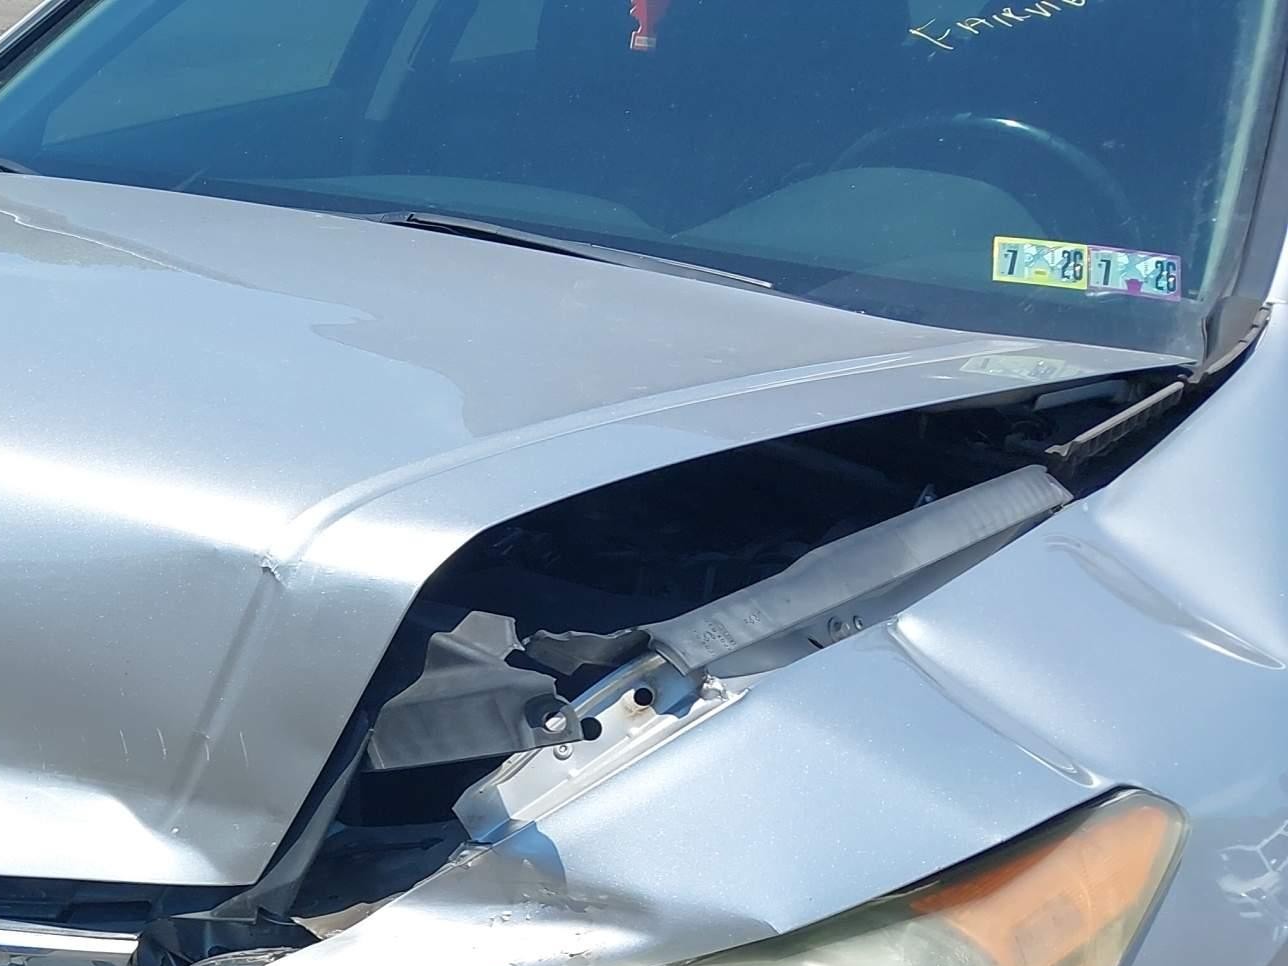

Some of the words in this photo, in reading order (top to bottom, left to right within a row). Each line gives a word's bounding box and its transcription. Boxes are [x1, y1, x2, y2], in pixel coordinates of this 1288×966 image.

[1004, 249, 1018, 276] 7
[1061, 249, 1084, 281] 26
[1099, 259, 1111, 286] 7
[1154, 260, 1177, 292] 26
